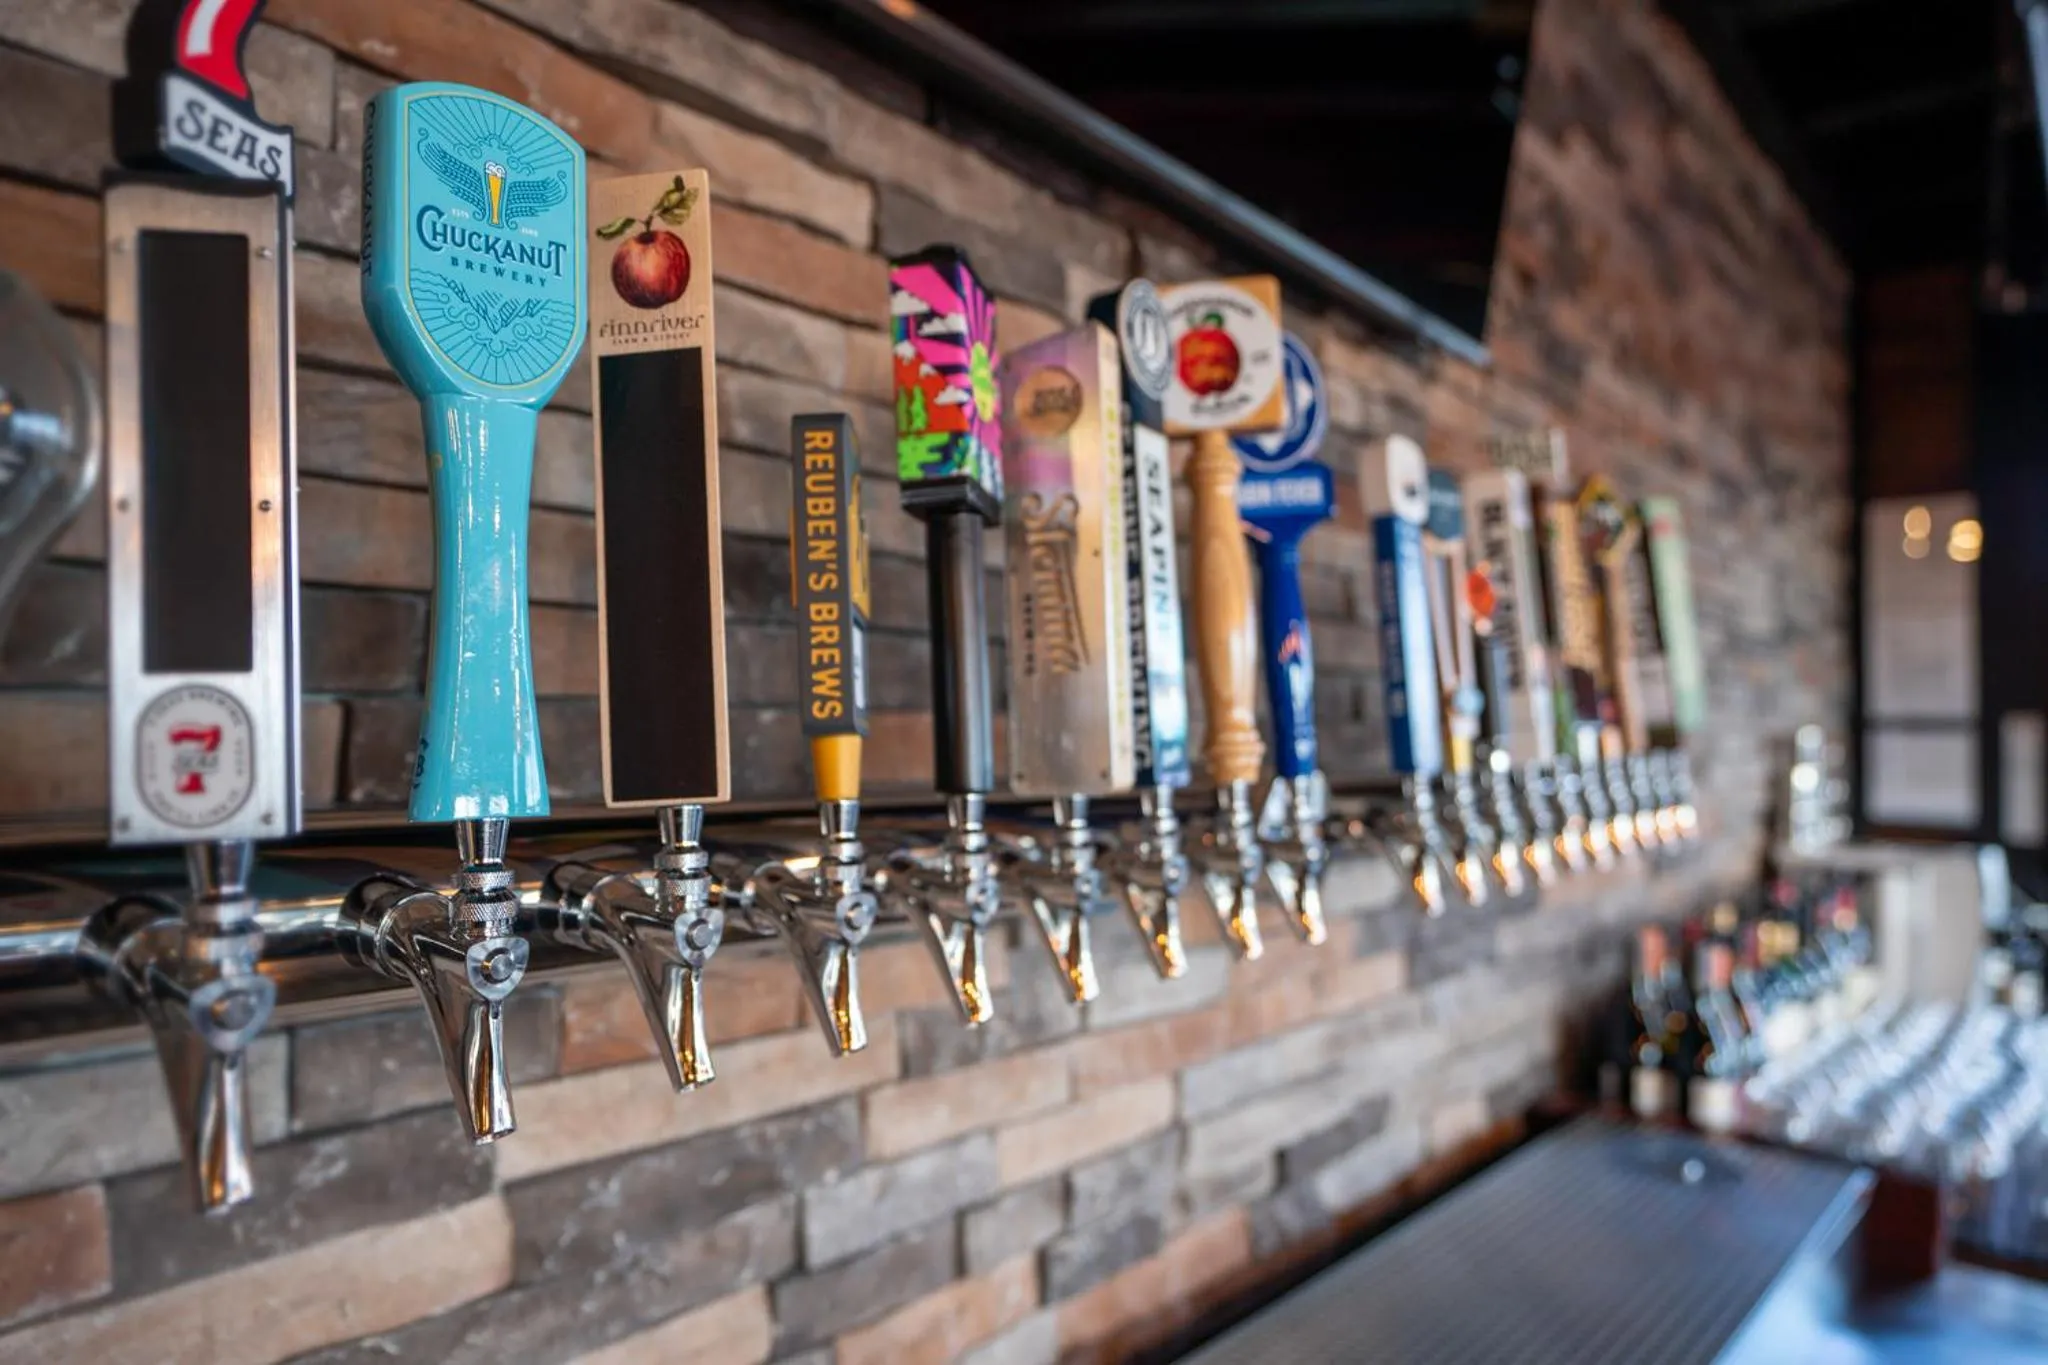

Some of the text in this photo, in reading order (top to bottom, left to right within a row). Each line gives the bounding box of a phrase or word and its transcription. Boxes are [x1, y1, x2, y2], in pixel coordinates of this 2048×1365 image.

[176, 99, 282, 181] SEAS
[416, 204, 567, 277] CHUCKANUT
[451, 256, 548, 288] BREWERY
[804, 430, 844, 721] REUBEN'S BREWS
